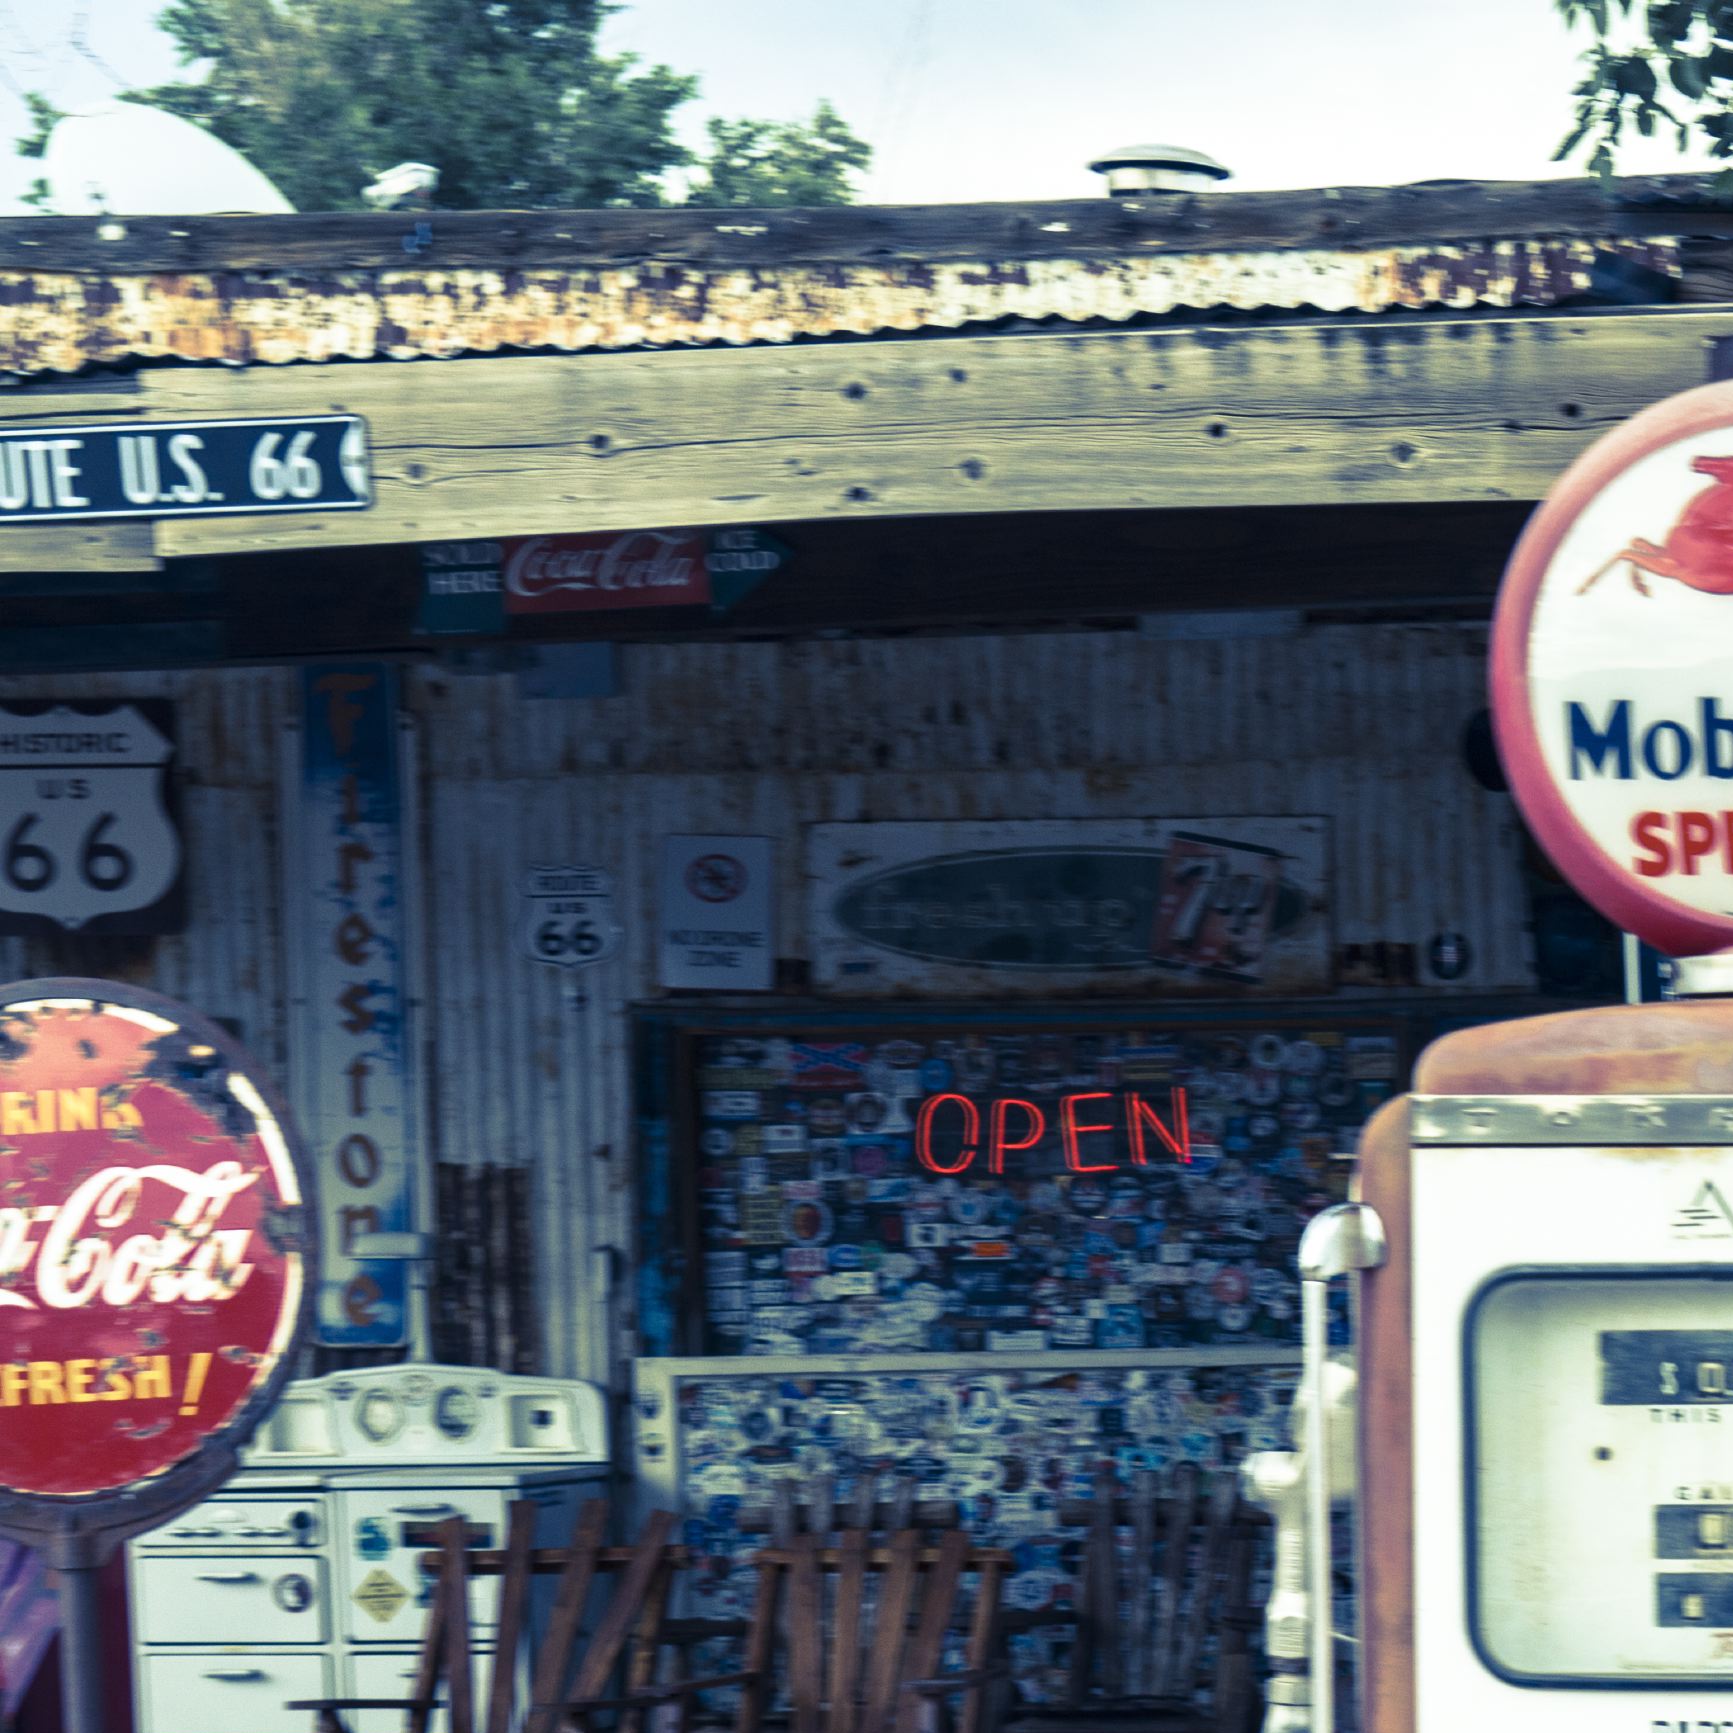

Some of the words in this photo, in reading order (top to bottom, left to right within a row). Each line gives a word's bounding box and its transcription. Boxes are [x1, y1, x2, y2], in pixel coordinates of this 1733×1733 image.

[117, 433, 226, 505] U.S.
[249, 430, 323, 501] 66
[428, 571, 505, 596] HERE
[506, 530, 695, 599] Coca-Cola
[0, 732, 132, 754] HISTORIC
[35, 778, 92, 800] US
[3, 811, 138, 893] 66
[534, 919, 605, 957] 66
[914, 1086, 1191, 1175] OPEN
[1648, 1407, 1723, 1424] THIS
